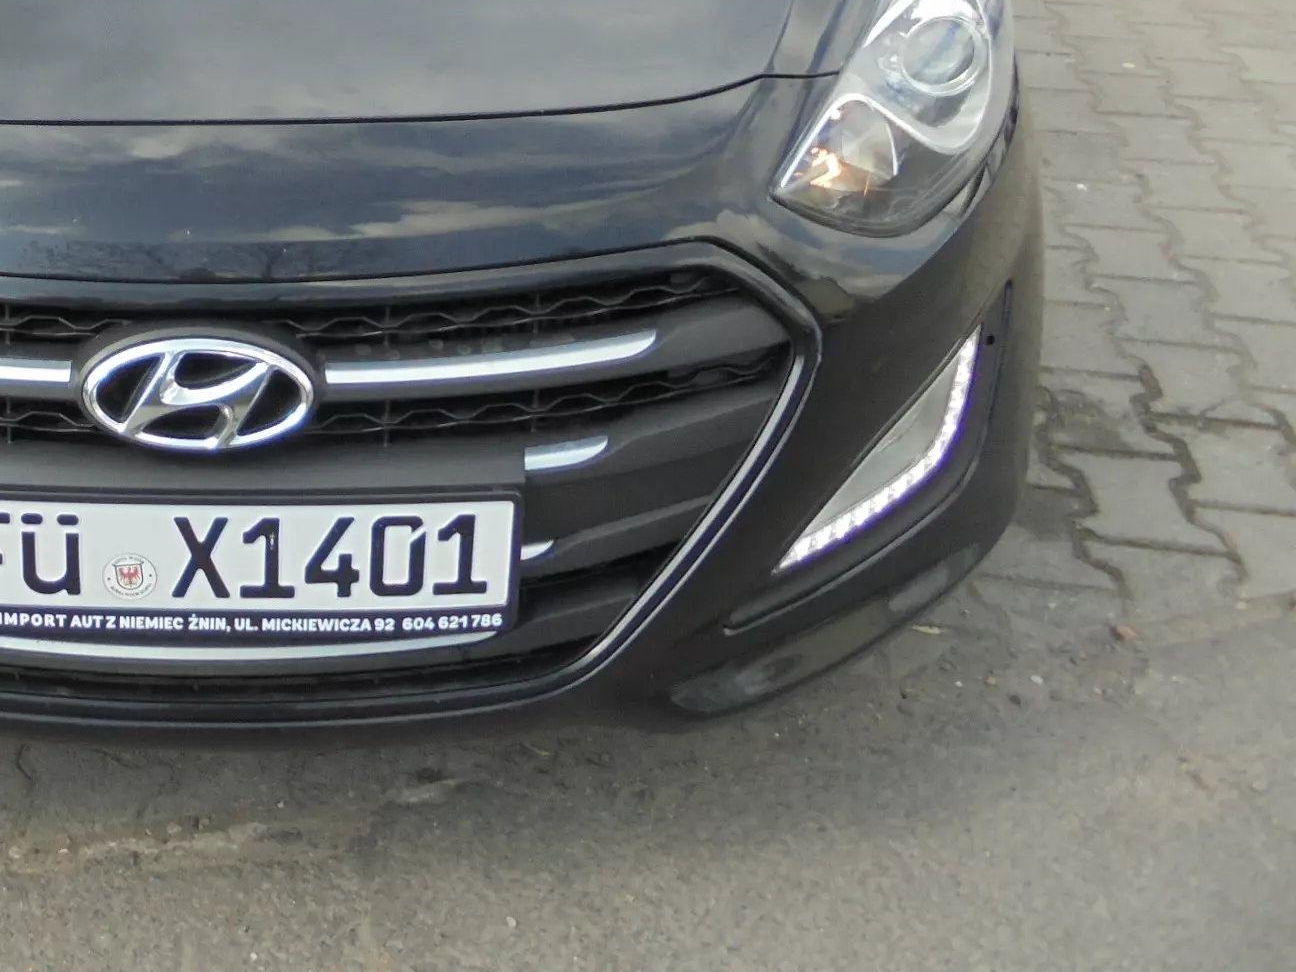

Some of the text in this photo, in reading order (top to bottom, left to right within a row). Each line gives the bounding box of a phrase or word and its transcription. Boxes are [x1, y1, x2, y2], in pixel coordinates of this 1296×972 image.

[171, 513, 488, 599] X1401
[70, 614, 105, 628] AUT
[105, 615, 117, 628] Z
[119, 615, 184, 630] NIEMIEC
[188, 613, 231, 633] ŻNIN,
[234, 617, 259, 631] UL.
[262, 617, 372, 632] MICKIEWICZA
[374, 617, 396, 631] 92
[402, 616, 435, 631] 604
[437, 615, 469, 630] 621
[470, 613, 503, 628] 786
